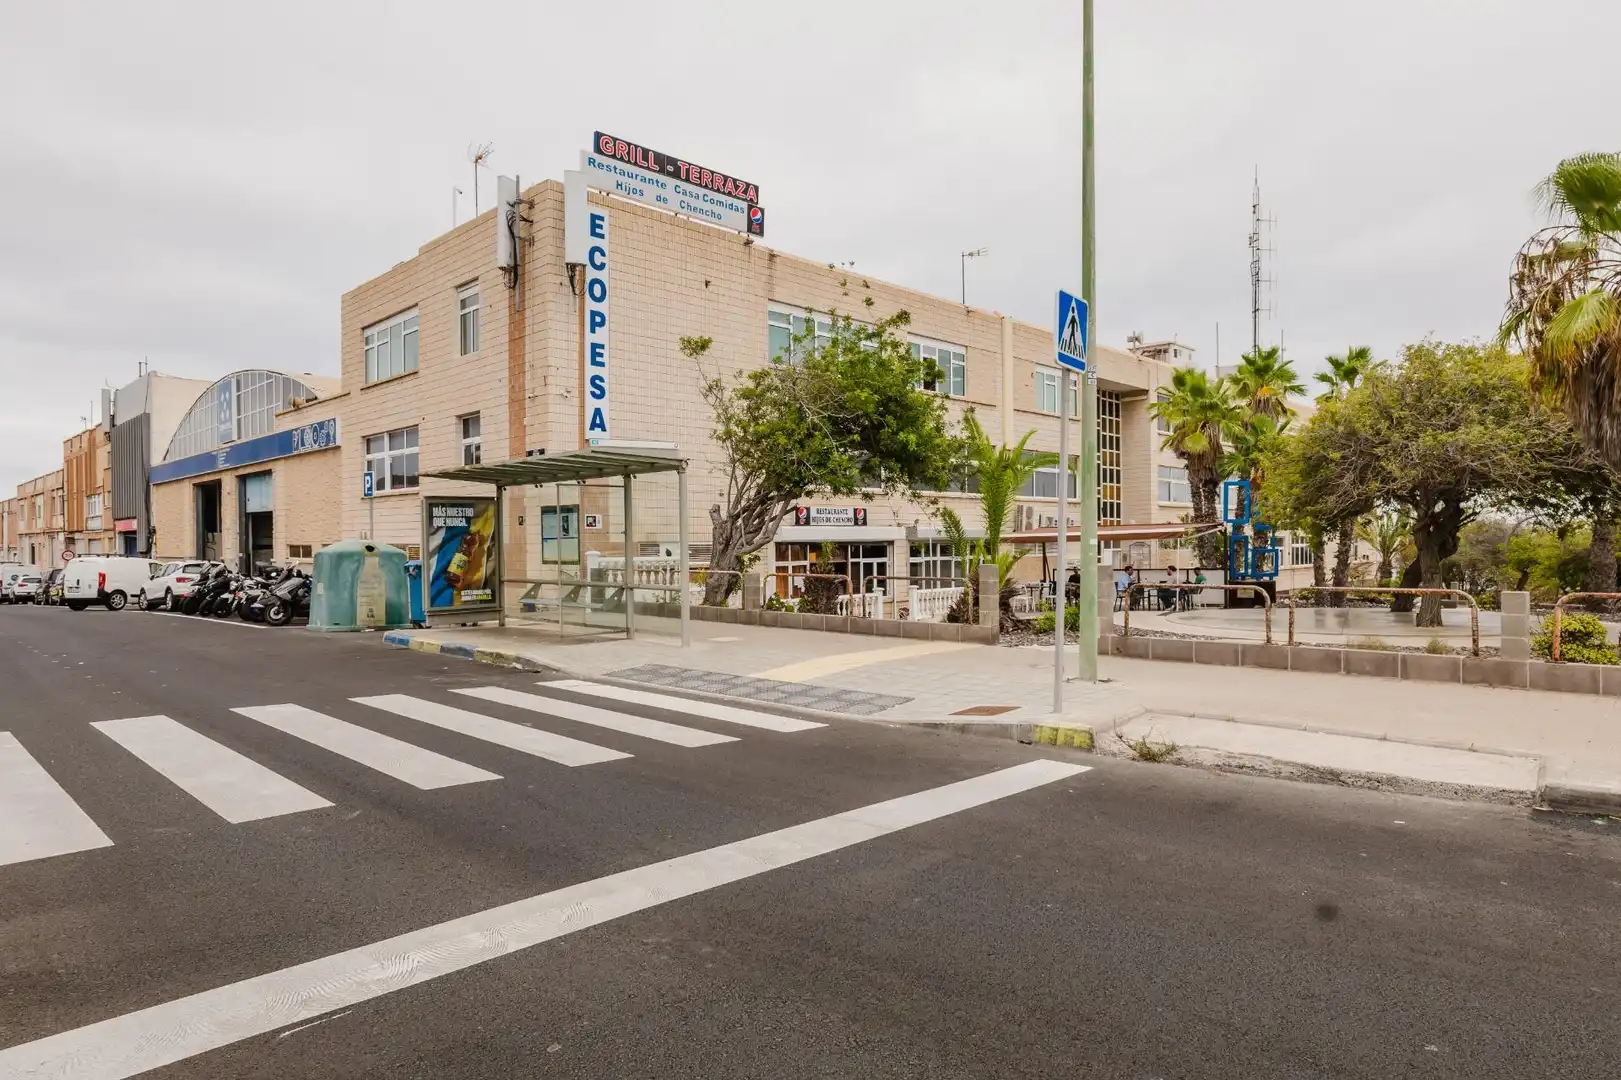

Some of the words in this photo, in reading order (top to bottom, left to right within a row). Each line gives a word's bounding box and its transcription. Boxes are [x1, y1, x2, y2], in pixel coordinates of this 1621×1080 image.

[600, 135, 660, 171] GRILL
[677, 161, 758, 204] TERRAZA
[587, 156, 668, 190] Restaurante
[674, 184, 700, 200] Casa
[702, 194, 746, 215] Comidas
[616, 180, 645, 197] Hijos
[655, 193, 669, 205] de
[679, 200, 723, 221] Chencho
[588, 212, 607, 433] ECOPESA
[364, 475, 372, 494] P
[432, 505, 446, 517] MÁS
[446, 507, 474, 517] NUESTRO
[811, 516, 825, 524] HIJOS
[816, 507, 849, 515] RESTAURANTE
[432, 517, 446, 528] QUE
[446, 517, 468, 527] NUNCA.
